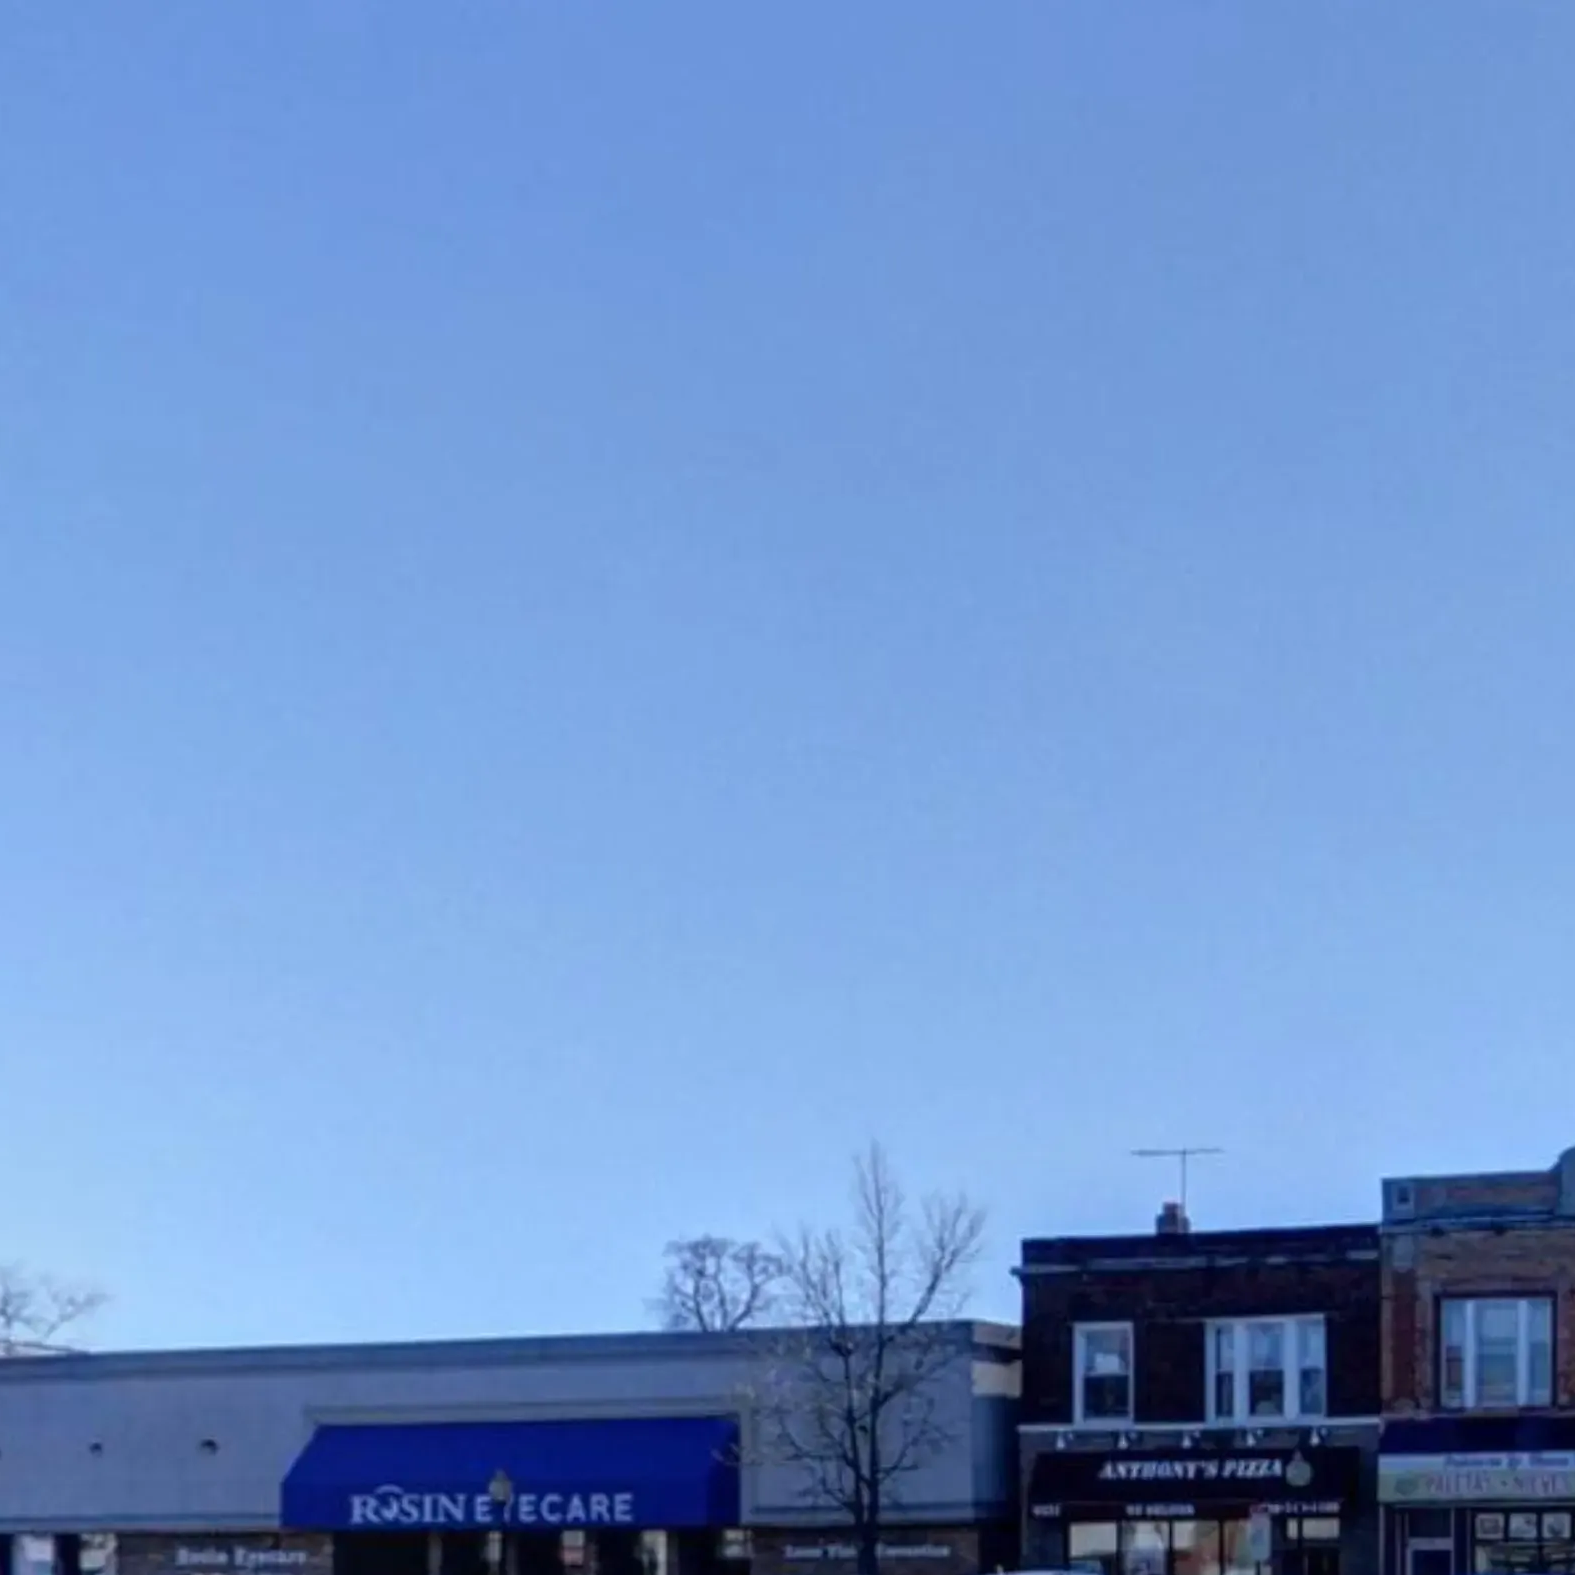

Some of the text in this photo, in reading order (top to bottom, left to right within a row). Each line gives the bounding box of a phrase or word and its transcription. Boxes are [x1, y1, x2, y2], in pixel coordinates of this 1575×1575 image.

[1097, 1459, 1283, 1480] ANTHONY'S PIZZA
[349, 1485, 467, 1525] ROSIN
